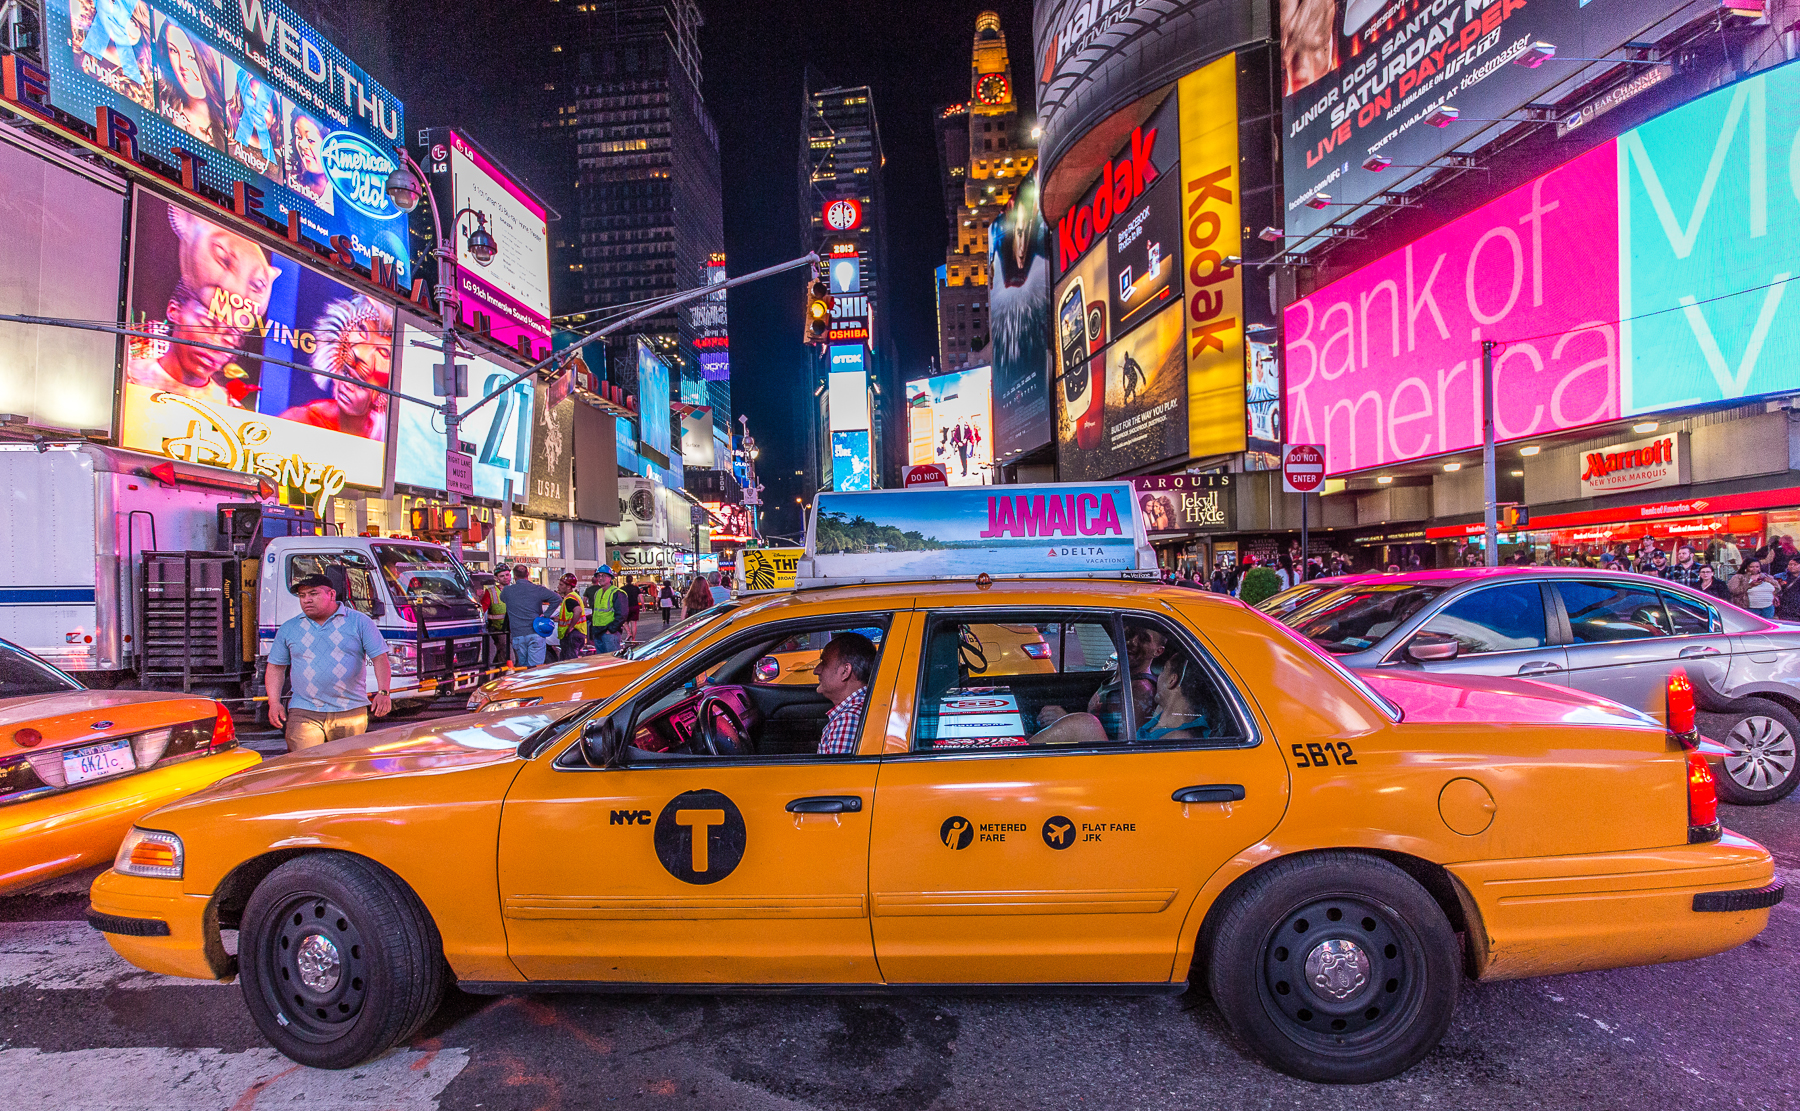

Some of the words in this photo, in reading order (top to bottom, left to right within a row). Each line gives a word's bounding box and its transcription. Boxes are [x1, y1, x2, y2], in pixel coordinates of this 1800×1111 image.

[1076, 1, 1131, 55] driving
[82, 55, 120, 89] Angie
[200, 12, 213, 28] to
[216, 24, 242, 50] you!
[245, 42, 273, 71] Last
[273, 67, 312, 98] chance
[313, 94, 324, 110] to
[326, 103, 348, 127] vote!
[240, 0, 326, 83] WED
[336, 65, 398, 140] THU
[1290, 86, 1339, 138] JUNIOR
[1342, 52, 1377, 94] DOS
[1381, 0, 1455, 61] SANTO
[1330, 5, 1461, 130] SATURDAY
[1367, 124, 1398, 154] TICKETS
[1399, 95, 1445, 135] AVAILABLE
[1446, 87, 1458, 101] AT
[1460, 33, 1531, 89] ticketmaster
[1386, 103, 1401, 120] ALSO
[1402, 78, 1434, 110] AVAILABLE
[1434, 71, 1445, 87] ON
[1582, 96, 1612, 116] CLEAR
[1612, 69, 1661, 99] CHANNEL
[1614, 76, 1661, 104] SPECTACOLOR
[1306, 118, 1352, 169] LIVE
[1358, 87, 1392, 128] ON
[322, 137, 394, 173] American
[433, 163, 447, 173] LG
[288, 175, 320, 203] Candice
[350, 170, 388, 210] Idol
[1058, 126, 1161, 273] Kodak
[1288, 167, 1340, 211] facebook.com/UFC
[1128, 205, 1150, 233] FACEBOOK
[1188, 164, 1236, 361] Kodak
[1286, 242, 1451, 392] Bank
[1466, 166, 1563, 326] of
[214, 287, 260, 315] MOST
[463, 278, 472, 291] LG
[513, 308, 528, 324] Sound
[208, 297, 317, 354] MOVING
[1286, 318, 1618, 475] America
[478, 373, 535, 473] 21
[1111, 421, 1122, 435] BUILT
[1122, 419, 1131, 430] FOR
[1132, 415, 1140, 426] THE
[1140, 410, 1153, 422] WAY
[1153, 403, 1164, 417] YOU
[448, 454, 459, 465] RIGHT
[461, 459, 471, 468] LANE
[453, 468, 466, 478] MUST
[1291, 454, 1301, 462] DO
[1581, 438, 1672, 481] Marriott
[448, 479, 458, 488] TURN
[460, 482, 472, 491] RIGHT
[537, 479, 560, 499] USPA
[924, 472, 939, 480] NOT
[1589, 479, 1604, 487] NEW
[1608, 475, 1627, 484] YORK
[1629, 468, 1667, 481] MARQUIS
[980, 493, 1122, 538] JAMAICA
[1181, 491, 1218, 512] Jekyll
[1186, 505, 1225, 526] Hyde
[1641, 506, 1655, 516] Bank
[1662, 503, 1690, 513] America
[267, 553, 276, 563] 6
[1061, 547, 1104, 556] DELTA
[1291, 742, 1358, 768] 5B12
[610, 810, 651, 825] NYC
[676, 809, 725, 872] T
[980, 823, 1027, 832] METERED
[980, 834, 1006, 842] FARE
[1082, 823, 1106, 832] FLAT
[1110, 823, 1136, 832] FARE
[1082, 834, 1101, 842] JFK
